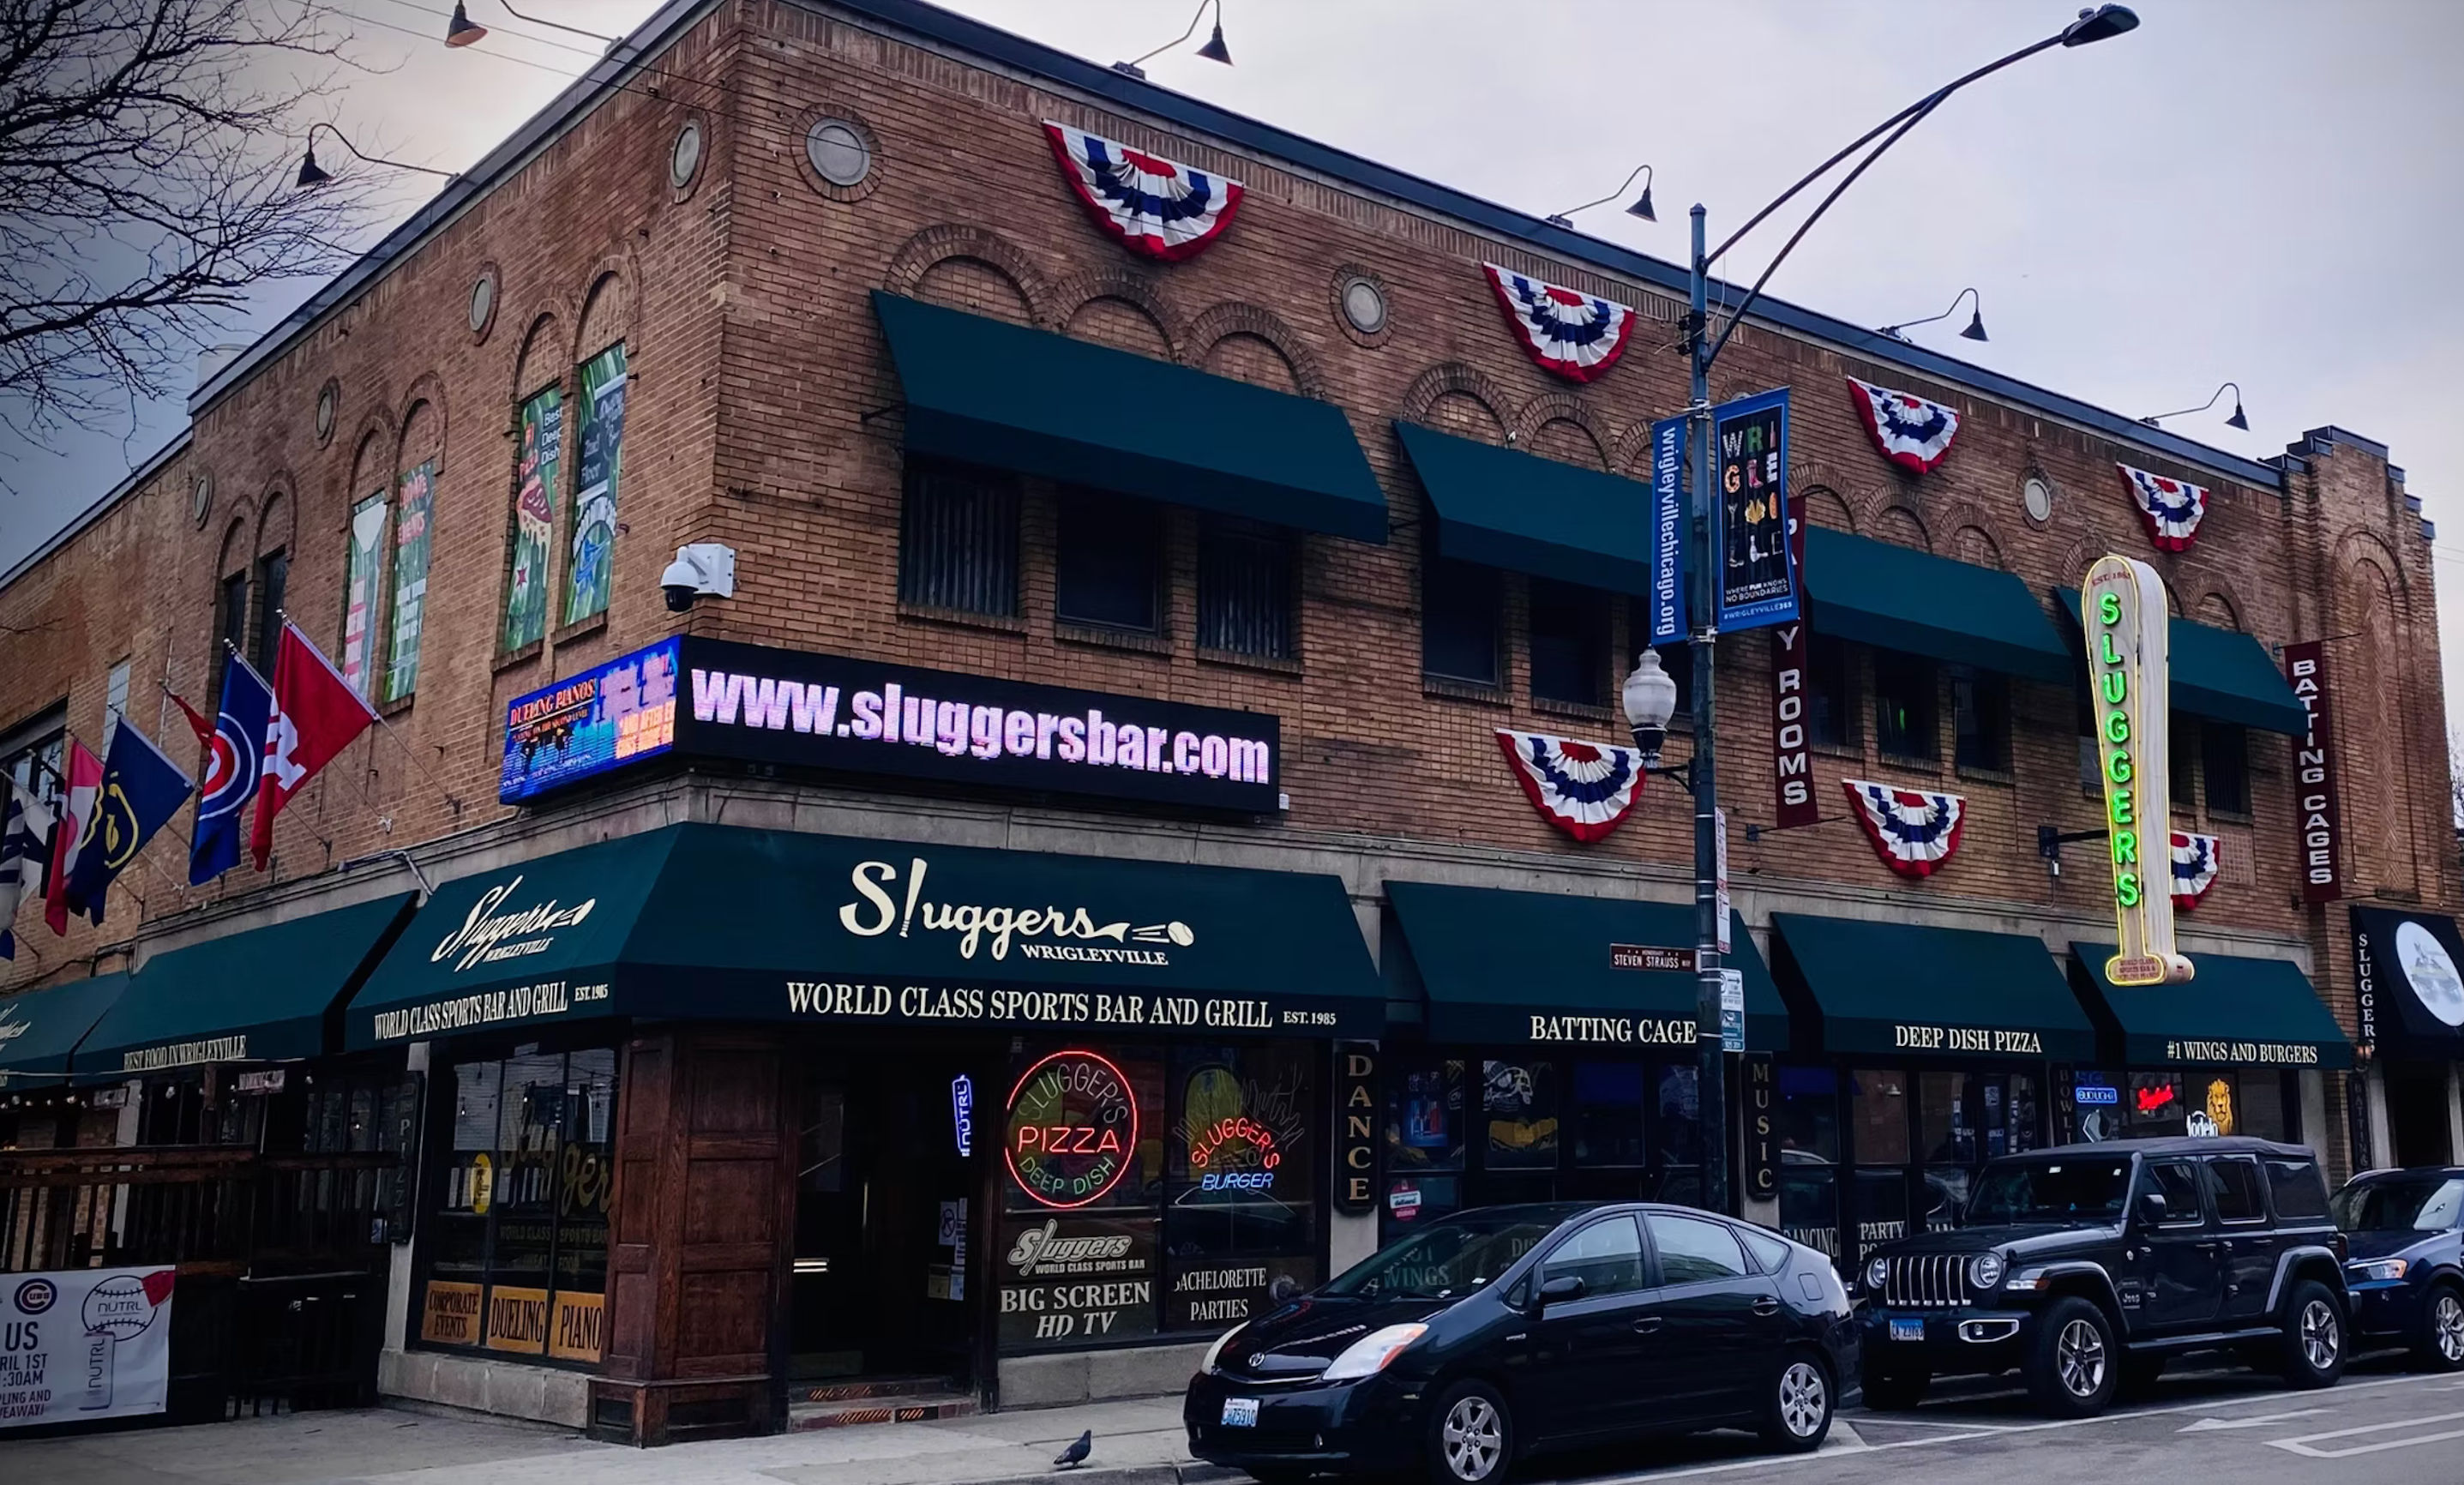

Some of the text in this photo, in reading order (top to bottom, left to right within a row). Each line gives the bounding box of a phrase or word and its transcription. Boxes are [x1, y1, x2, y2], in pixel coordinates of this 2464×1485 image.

[1656, 426, 1680, 636] wrigleyvillechicago.org
[1725, 585, 1749, 596] WHERE
[1725, 584, 1788, 603] NO BOUNDARIES
[690, 668, 1270, 785] www.sluggersbar.com
[1778, 668, 1808, 806] ROOMS
[2098, 592, 2141, 907] SLUGGERS
[2293, 658, 2333, 885] BATTING CAGES
[430, 875, 568, 972] Sluggers
[838, 857, 1132, 960] Sluggers
[1019, 942, 1169, 965] WRIGLEYVILLE
[1614, 953, 1643, 967] STEVEN
[1645, 955, 1680, 969] STRAUSS
[375, 1010, 408, 1041] WORLD
[409, 1004, 441, 1035] CLASS
[440, 994, 483, 1030] SPORTS
[482, 990, 505, 1023] BAR
[505, 986, 530, 1019] AND
[531, 980, 568, 1015] GRILL
[786, 982, 1337, 1029] WORLD CLASS SPORTS BAR AND GRILL EST. 1985
[1529, 1015, 1633, 1043] BATTING
[1638, 1019, 1698, 1044] CAGE
[1895, 1025, 2043, 1054] DEEP DISH PIZZA
[123, 1034, 247, 1071] BEST FOOD IN WRIGLEYVILLE
[2167, 1040, 2318, 1064] #1 WINGS AND BURGERS
[1016, 1062, 1129, 1125] SLUGGER'S
[1018, 1125, 1121, 1154] PIZZA
[1347, 1054, 1373, 1201] DANCE
[1752, 1063, 1773, 1189] MUSIC
[1191, 1116, 1281, 1170] SLUGGER'S
[1019, 1155, 1116, 1195] DEEP DISH
[1200, 1171, 1275, 1192] BURGER
[1858, 1220, 1906, 1241] PARTY
[1007, 1218, 1133, 1277] Sluggers
[1035, 1259, 1146, 1275] WORLD CLASS SPORTS BAR
[1384, 1265, 1451, 1288] WINGS
[429, 1289, 480, 1315] CORPORATE
[1000, 1279, 1151, 1314] BIG SCREEN
[1189, 1297, 1249, 1321] PARTIES
[434, 1314, 468, 1338] EVENTS
[490, 1298, 545, 1343] DUELING
[1035, 1310, 1118, 1340] HD TV
[4, 1321, 39, 1351] US
[26, 1353, 49, 1370] 1ST
[28, 1389, 51, 1404] AND
